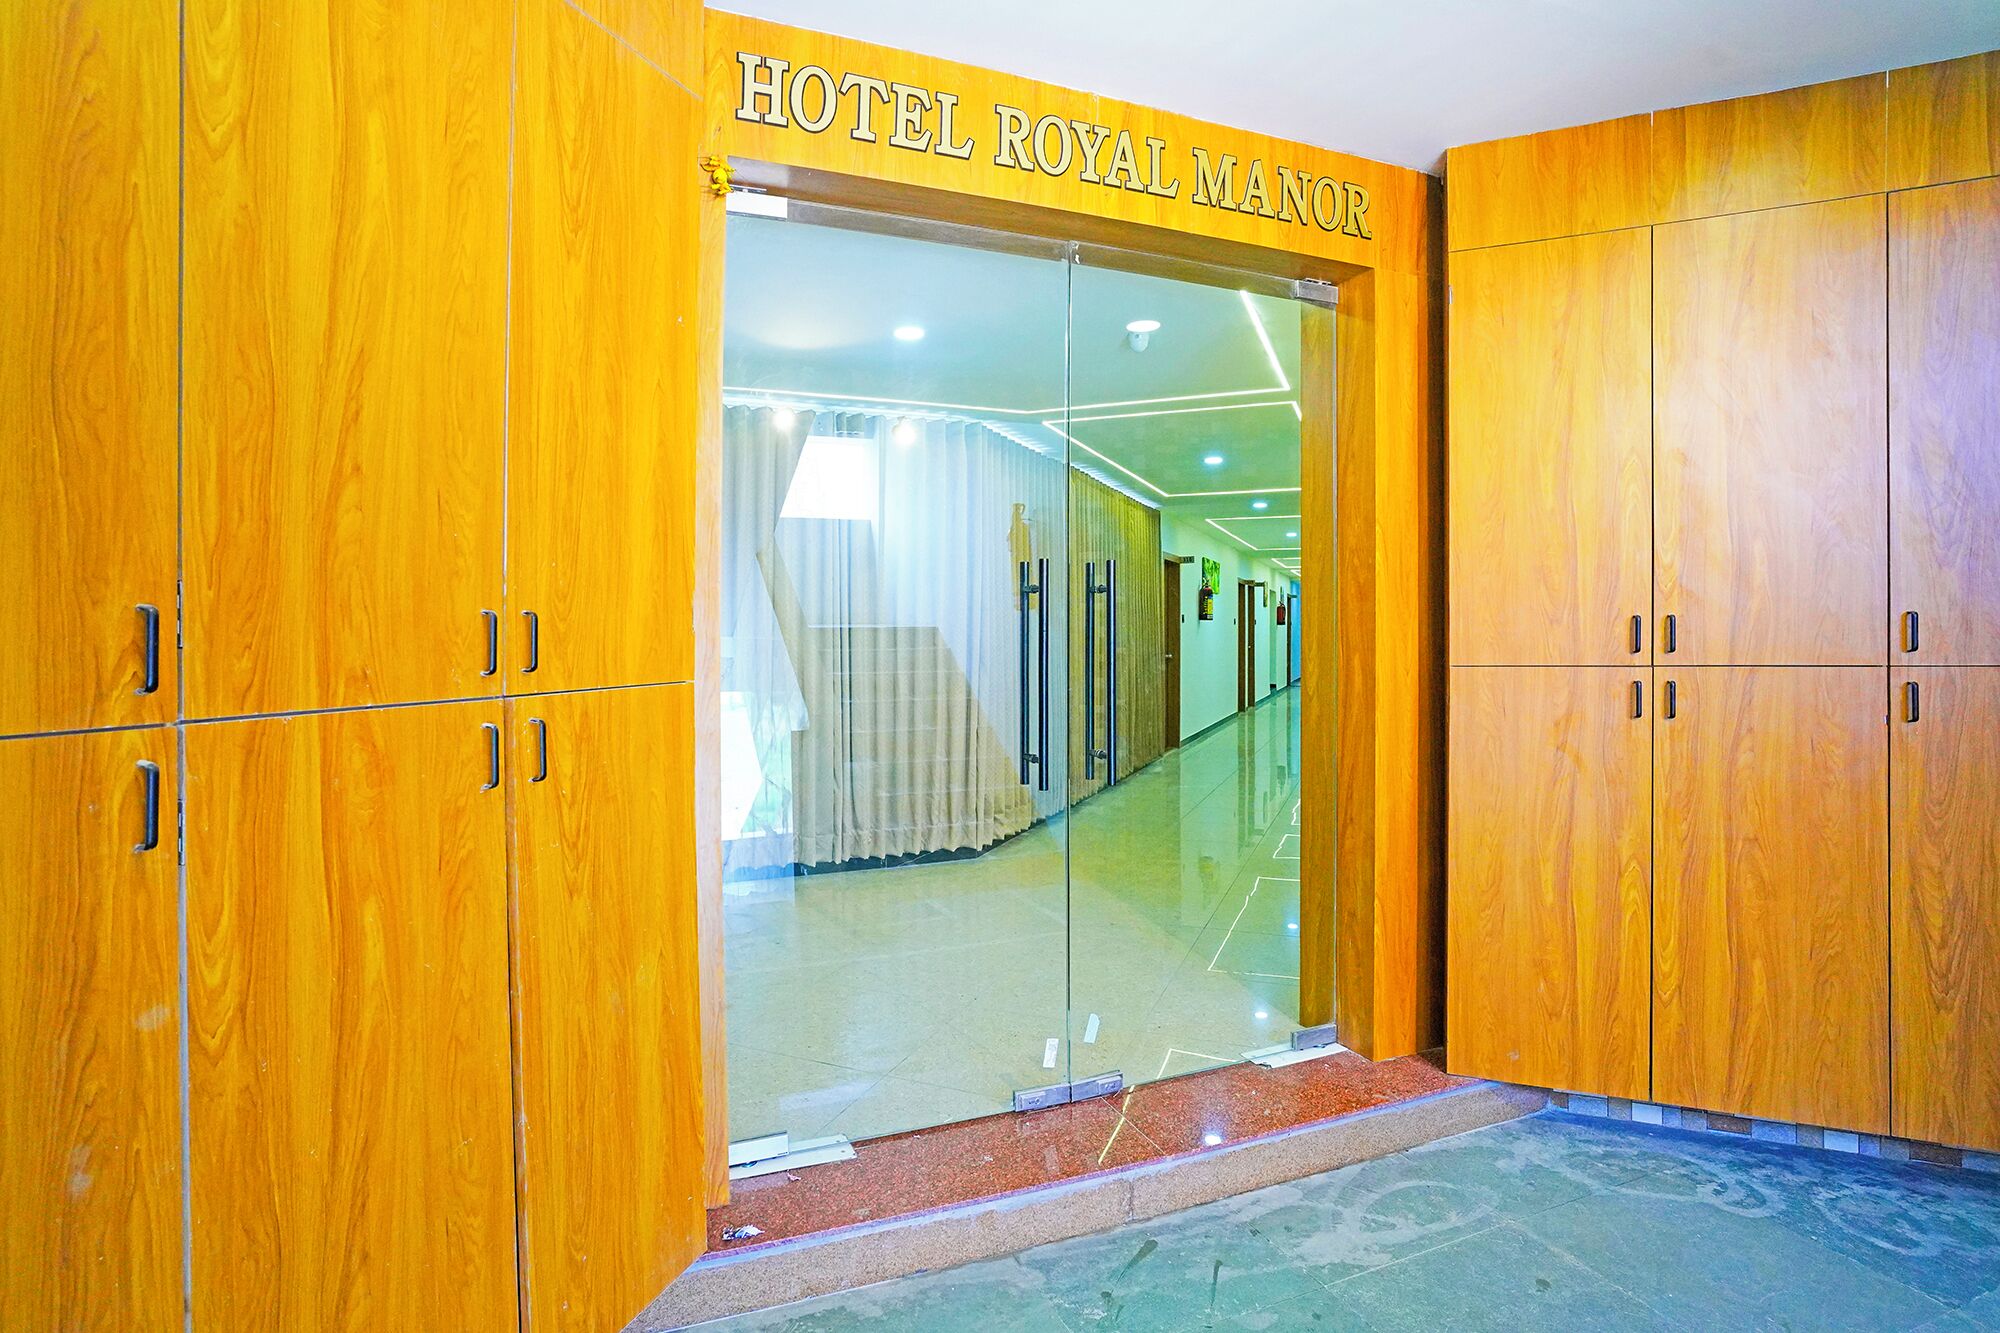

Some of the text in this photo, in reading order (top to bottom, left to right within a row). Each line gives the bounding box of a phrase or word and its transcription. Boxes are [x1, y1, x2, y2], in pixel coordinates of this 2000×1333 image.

[736, 52, 1372, 240] HOTEL ROYAL MANOR
